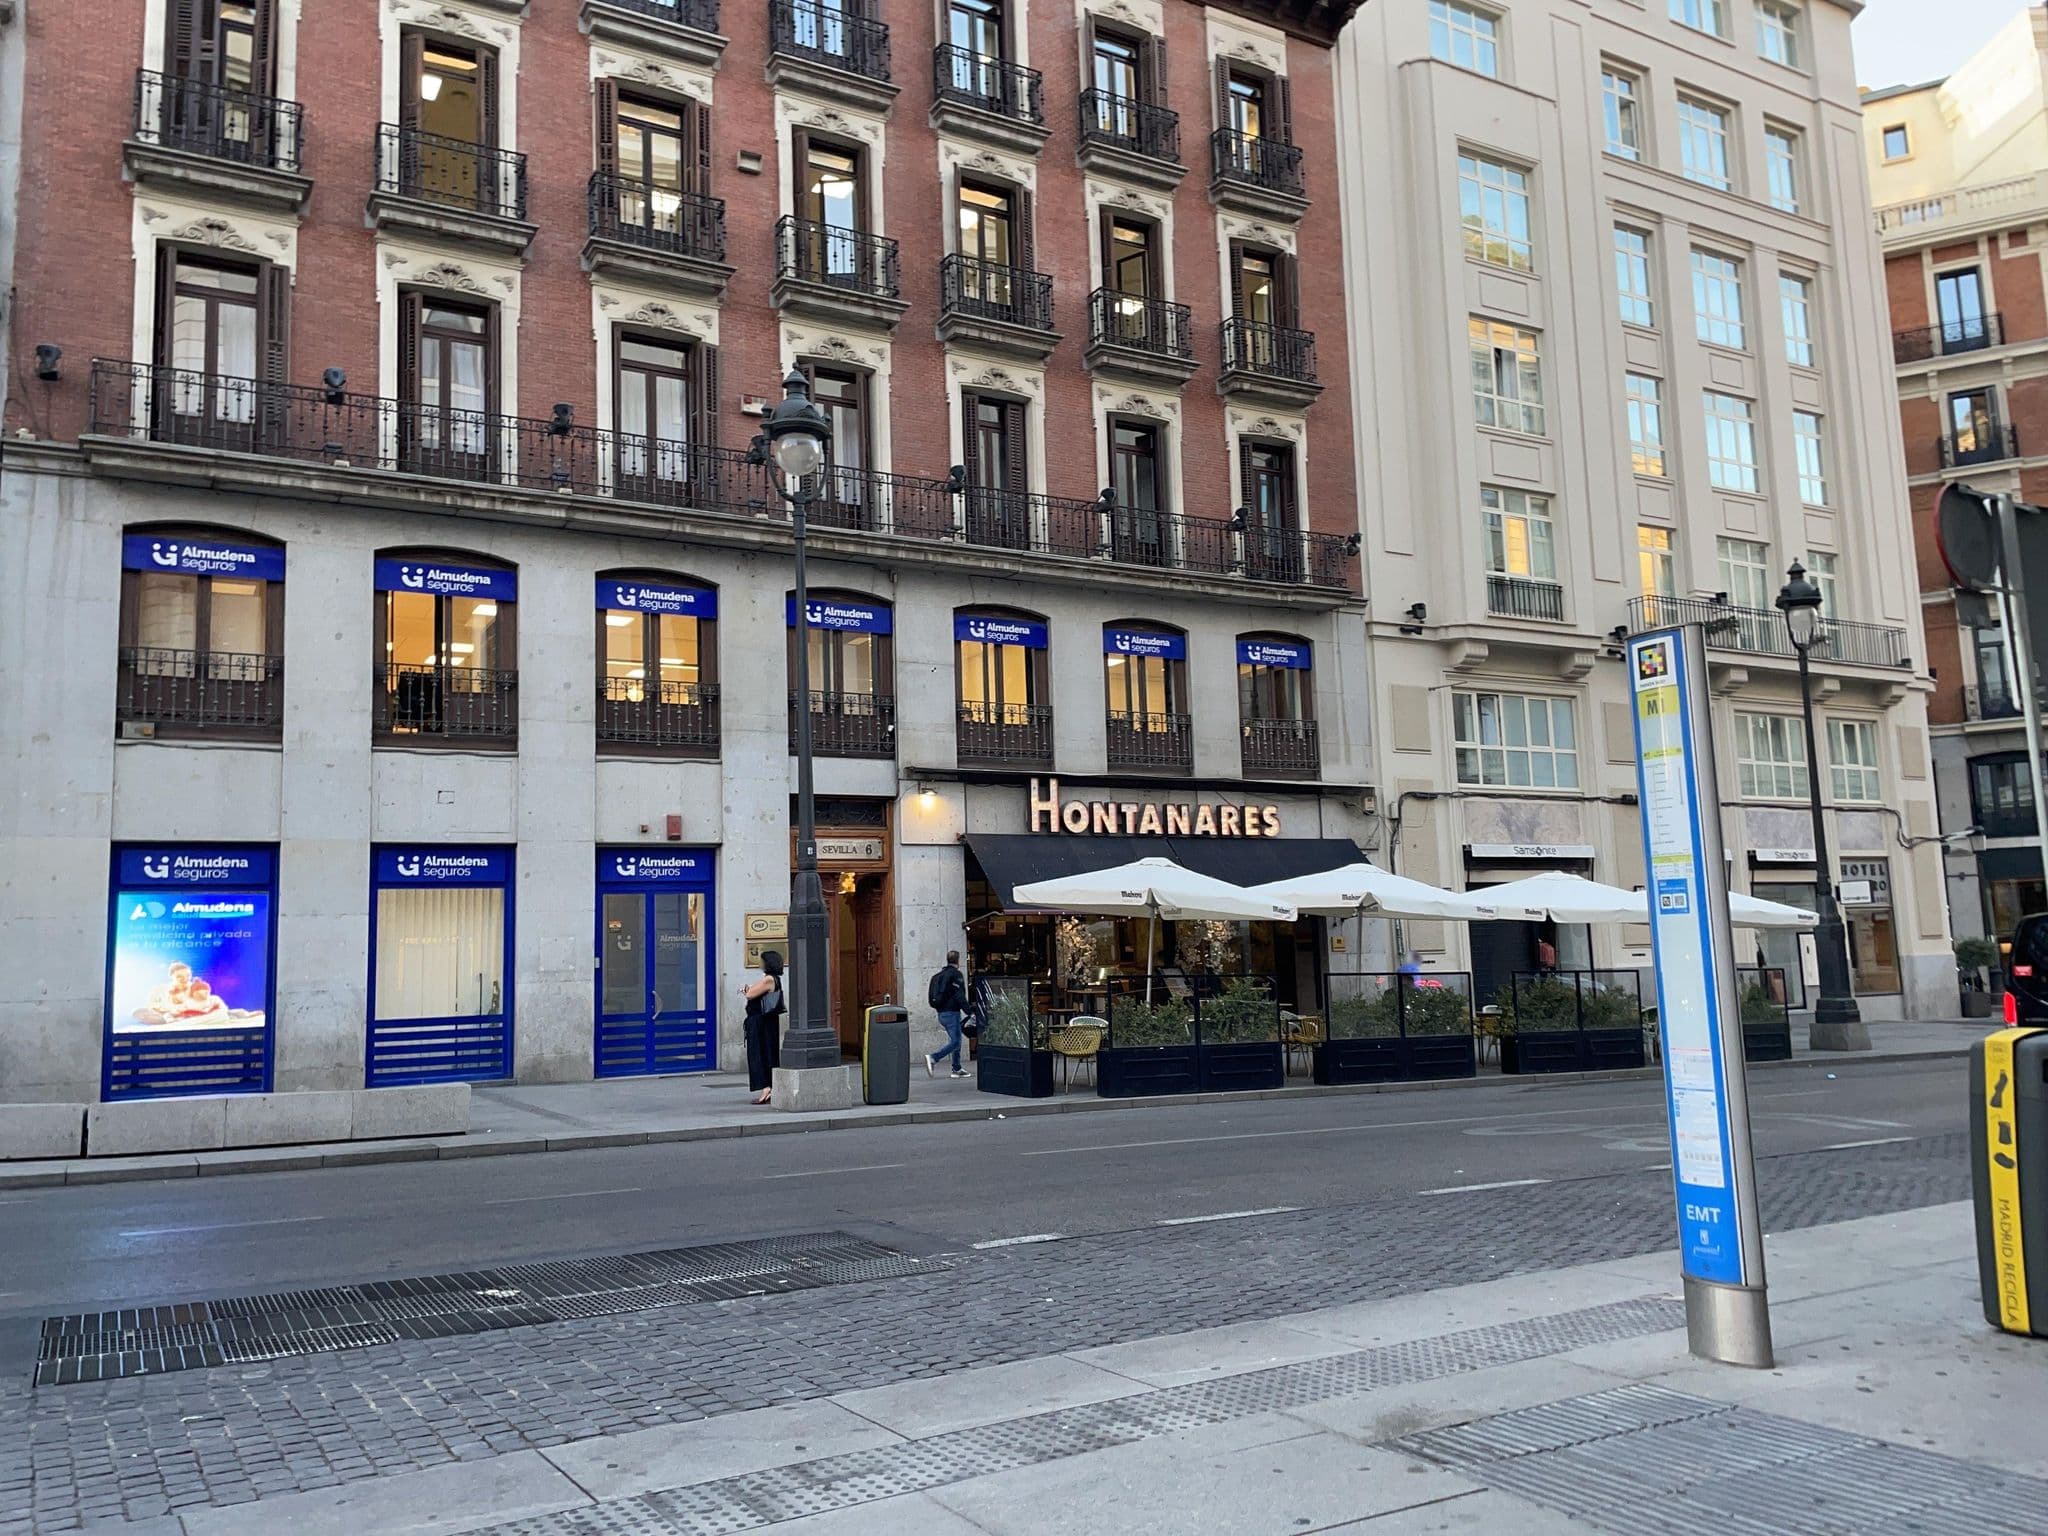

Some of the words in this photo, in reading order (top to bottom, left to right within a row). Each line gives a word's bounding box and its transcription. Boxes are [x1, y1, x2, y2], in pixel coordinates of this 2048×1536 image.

[182, 546, 256, 563] Almudena
[182, 558, 236, 571] seguros
[427, 569, 491, 585] Almudena
[427, 580, 474, 593] seguros
[639, 589, 695, 603] Almudena
[639, 600, 680, 610] seguros
[824, 607, 873, 619] Almudena
[824, 616, 861, 627] seguros
[987, 623, 1030, 634] Almudena
[987, 632, 1019, 641] seguros
[1131, 636, 1170, 647] Almudena
[1131, 645, 1160, 653] seguros
[1030, 777, 1280, 837] HONTANARES
[822, 845, 858, 854] SEVILLA
[865, 844, 873, 855] 6
[174, 856, 248, 868] Almudena
[423, 856, 488, 866] Almudena
[639, 857, 695, 867] Almudena
[174, 868, 229, 881] seguros
[423, 867, 471, 878] seguros
[639, 867, 681, 878] seguros
[1840, 864, 1885, 876] HOTEL
[172, 902, 254, 914] Almudena
[1686, 1203, 1721, 1224] EMT
[1998, 1198, 2014, 1259] MADRID
[2003, 1262, 2018, 1323] RECICLA
